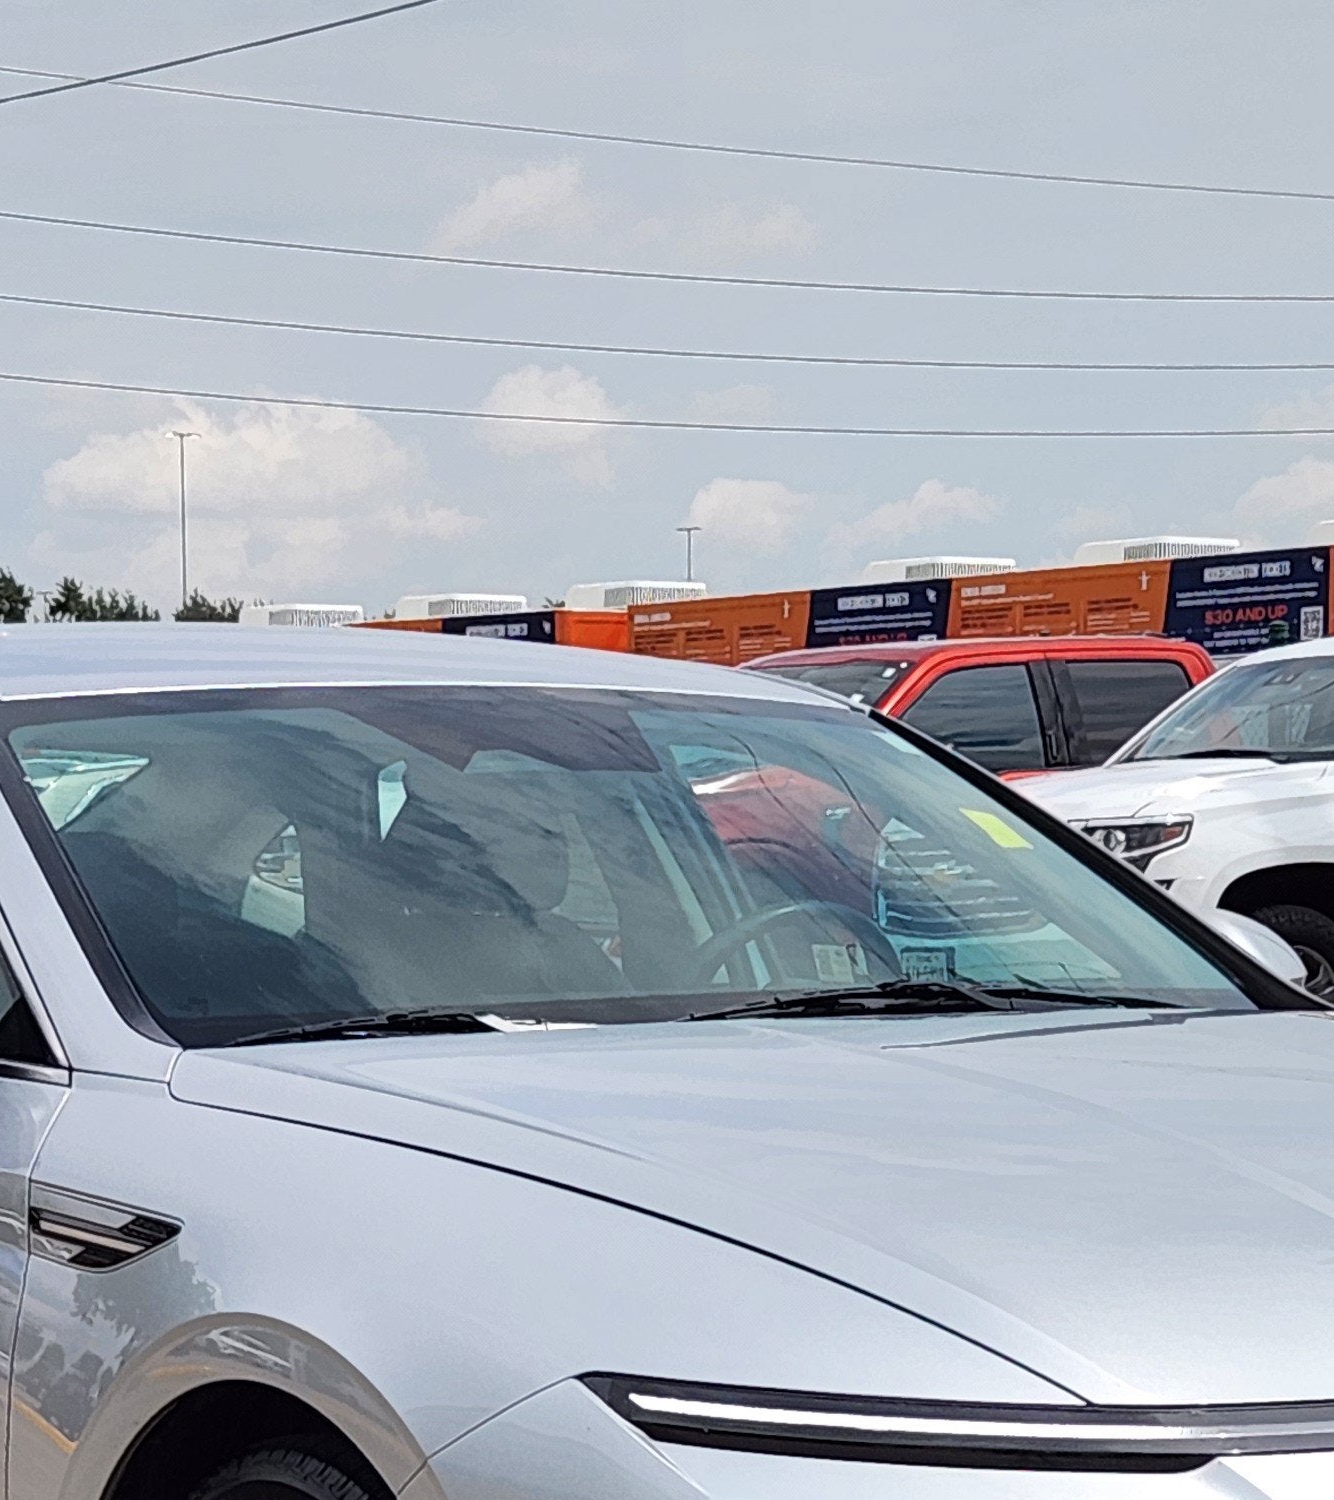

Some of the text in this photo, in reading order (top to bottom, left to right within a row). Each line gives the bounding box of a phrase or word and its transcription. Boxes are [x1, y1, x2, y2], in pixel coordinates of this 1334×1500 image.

[1204, 604, 1288, 625] $30 AND UP
